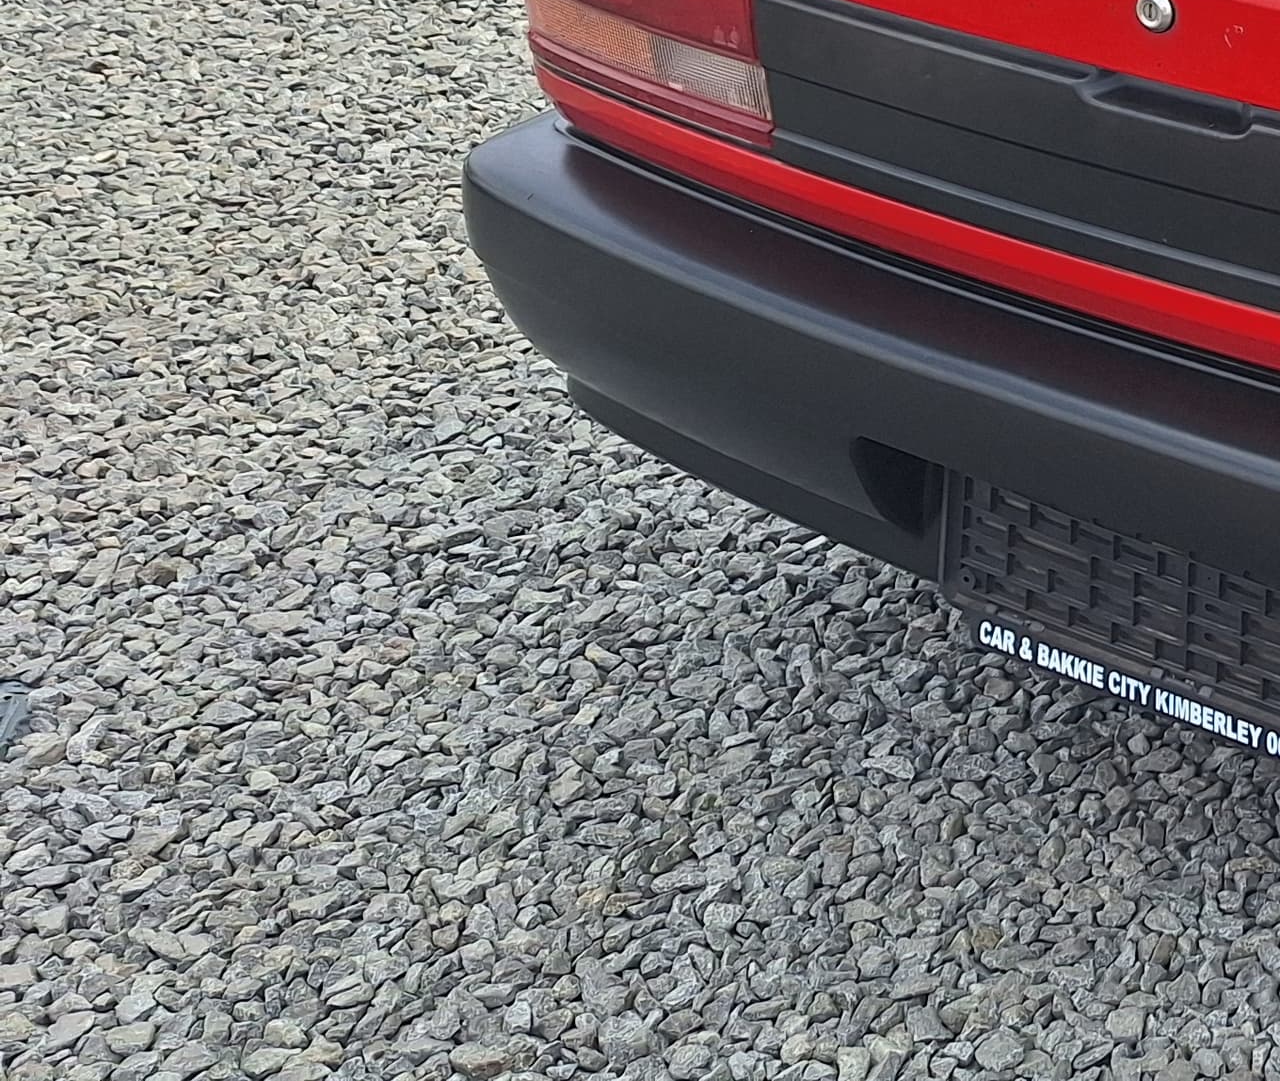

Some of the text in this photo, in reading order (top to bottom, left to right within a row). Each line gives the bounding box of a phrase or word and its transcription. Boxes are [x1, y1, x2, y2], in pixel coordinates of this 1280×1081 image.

[979, 621, 1016, 655] CAR
[1018, 636, 1033, 662] &
[1037, 642, 1105, 689] BAKKIE
[1108, 671, 1152, 706] CITY
[1155, 687, 1263, 749] KIMBERLEY
